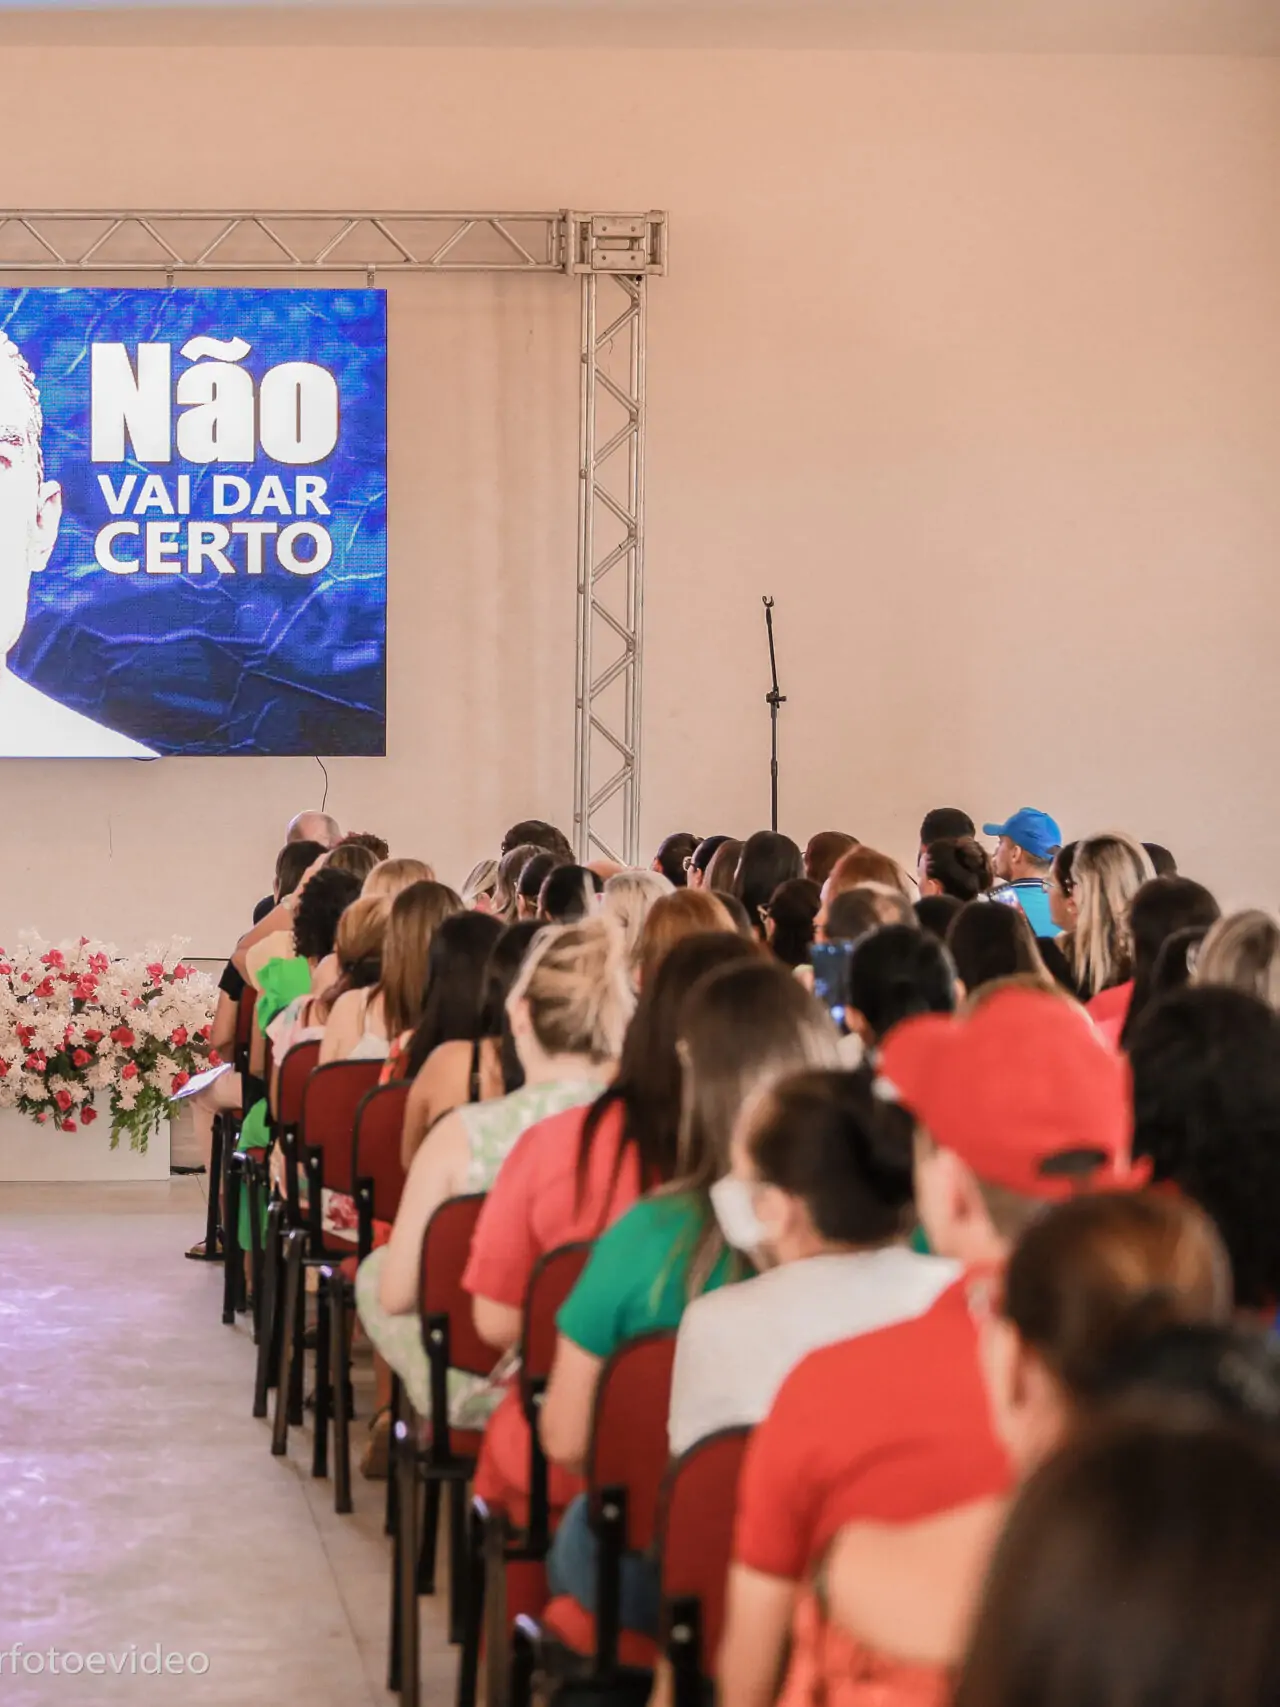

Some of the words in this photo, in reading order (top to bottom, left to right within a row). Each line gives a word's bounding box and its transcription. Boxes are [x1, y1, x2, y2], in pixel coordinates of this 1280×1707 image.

[91, 336, 340, 464] Não
[97, 475, 191, 515] VAI
[213, 475, 331, 515] DAR
[94, 521, 333, 575] CERTO
